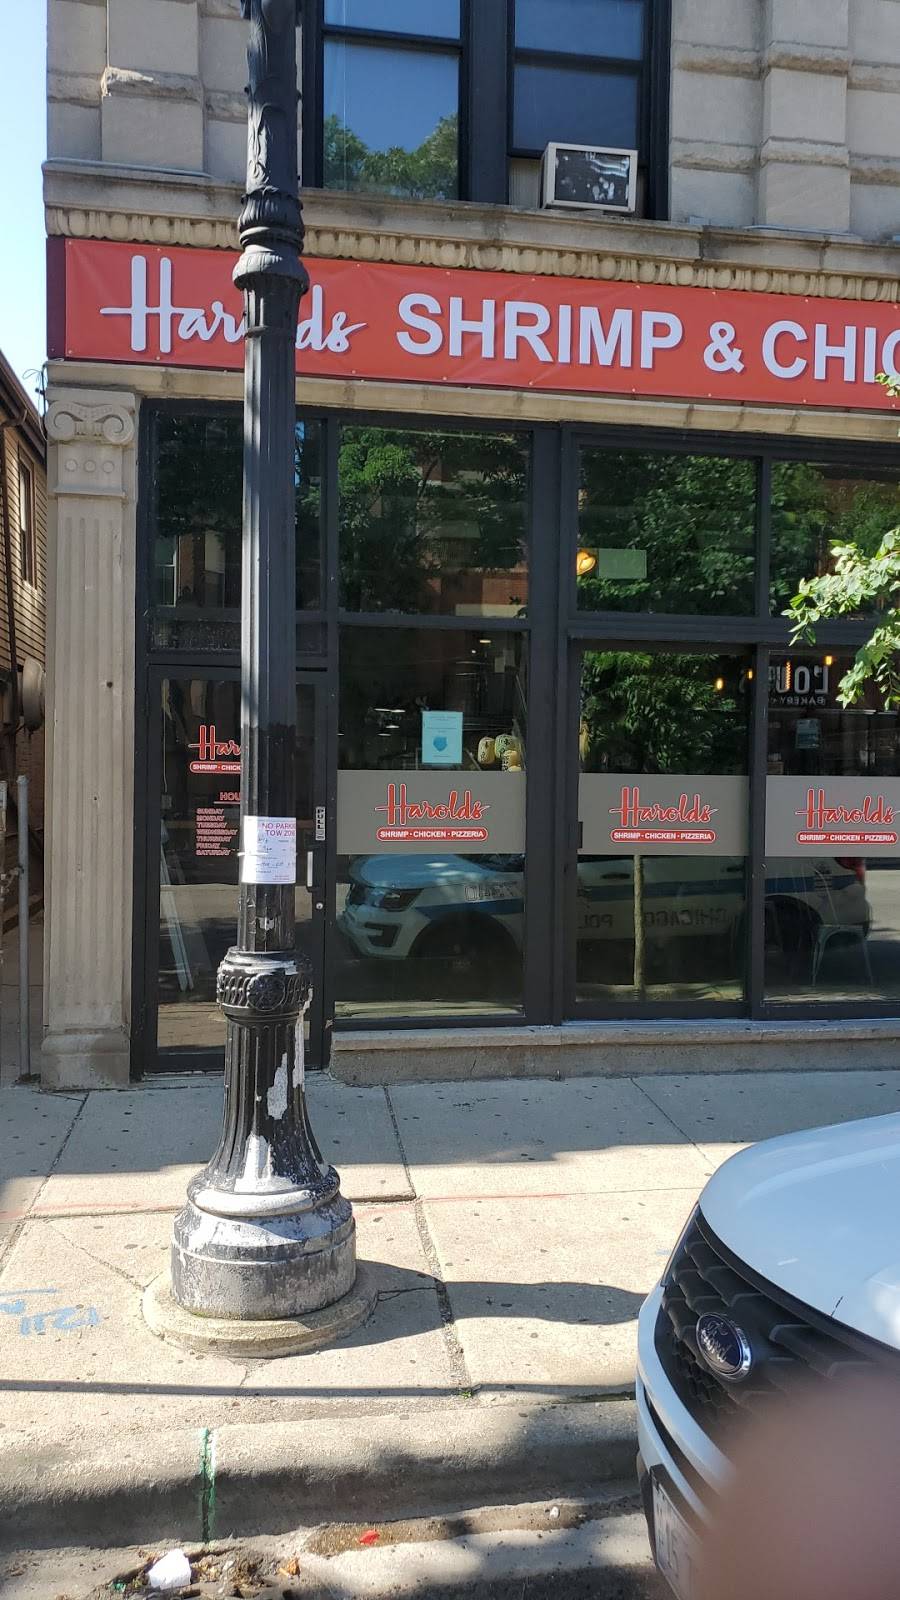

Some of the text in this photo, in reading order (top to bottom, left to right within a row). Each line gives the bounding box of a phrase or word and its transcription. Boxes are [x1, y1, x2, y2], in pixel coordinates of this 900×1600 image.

[100, 255, 367, 353] Hards
[396, 293, 684, 369] SHRIMP
[703, 321, 745, 373] &
[188, 725, 241, 760] Har
[219, 791, 241, 801] HOU
[375, 783, 491, 826] Harolds
[609, 786, 718, 828] Harolds
[795, 789, 900, 829] Harolds
[317, 809, 325, 829] PULL
[644, 832, 677, 840] CHICKEN
[699, 1319, 734, 1364] Ford
